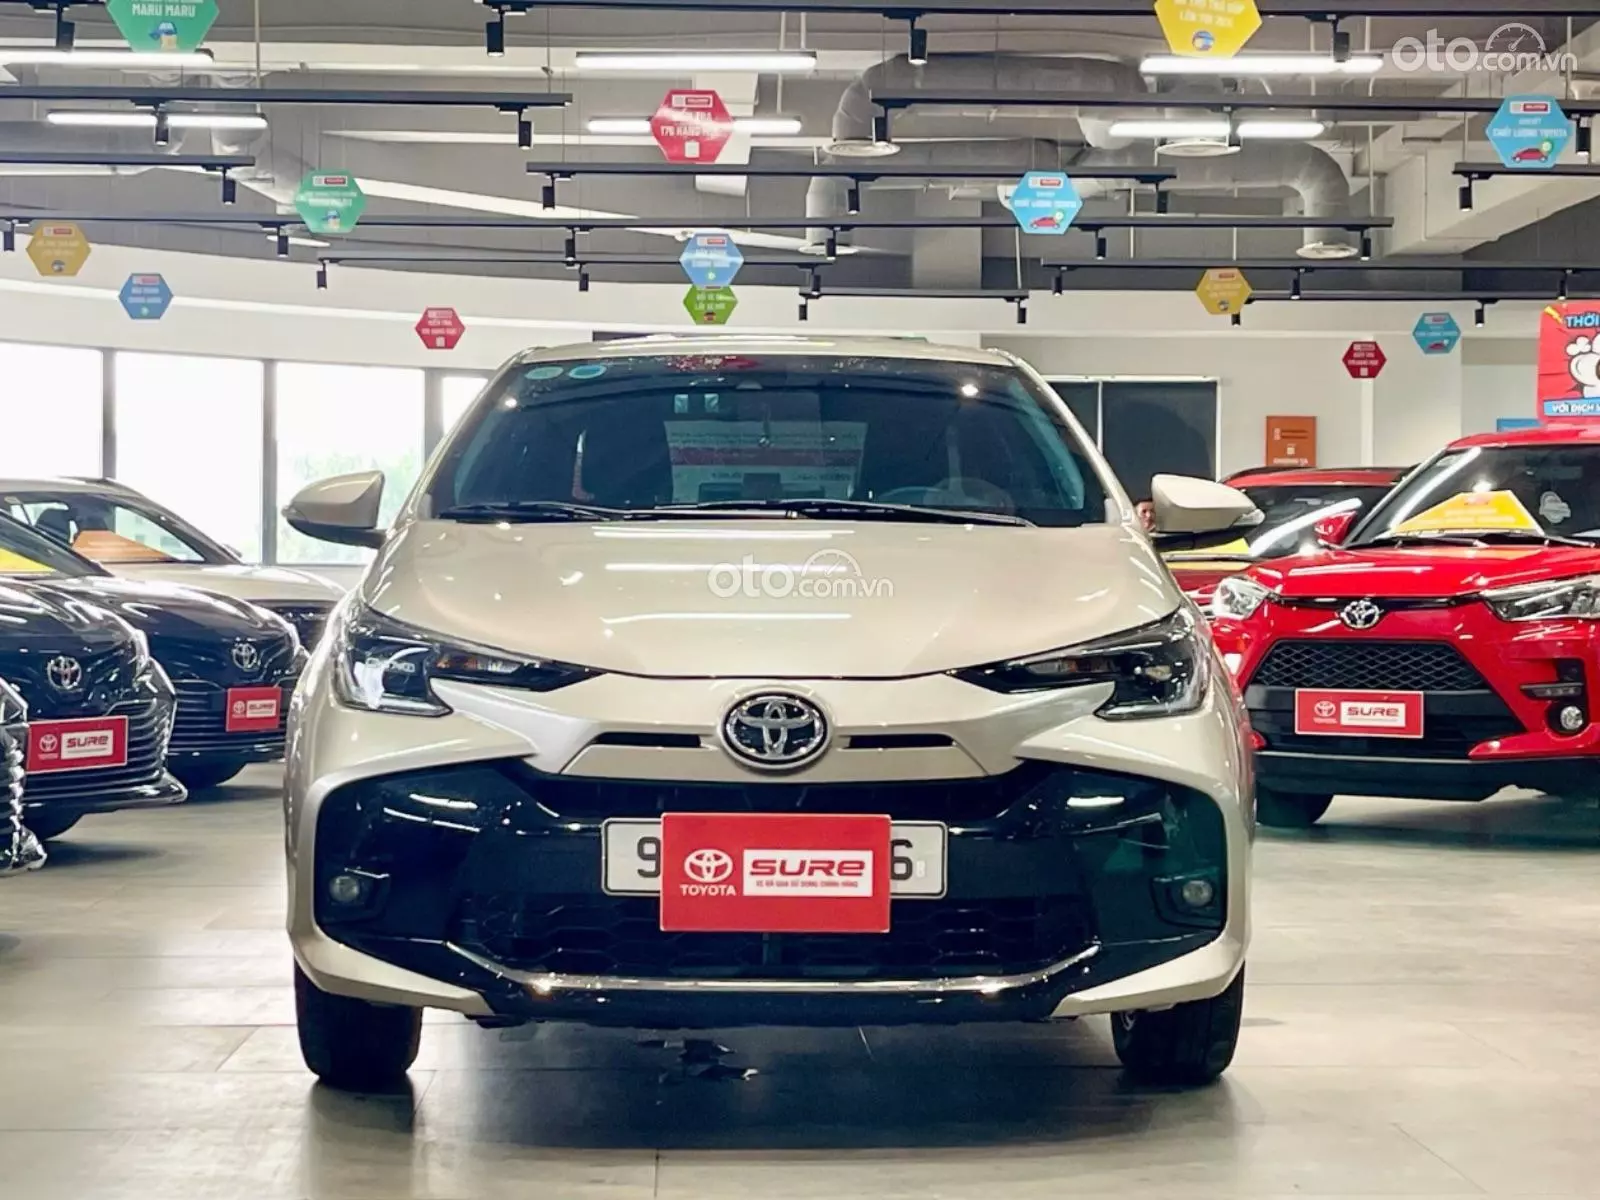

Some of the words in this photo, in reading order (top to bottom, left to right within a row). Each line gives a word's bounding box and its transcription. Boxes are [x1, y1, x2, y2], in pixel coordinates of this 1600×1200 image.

[131, 4, 162, 16] MARU
[165, 5, 196, 17] MARU
[637, 836, 661, 878] 9
[890, 839, 913, 880] 6
[679, 884, 737, 897] TOYOTA
